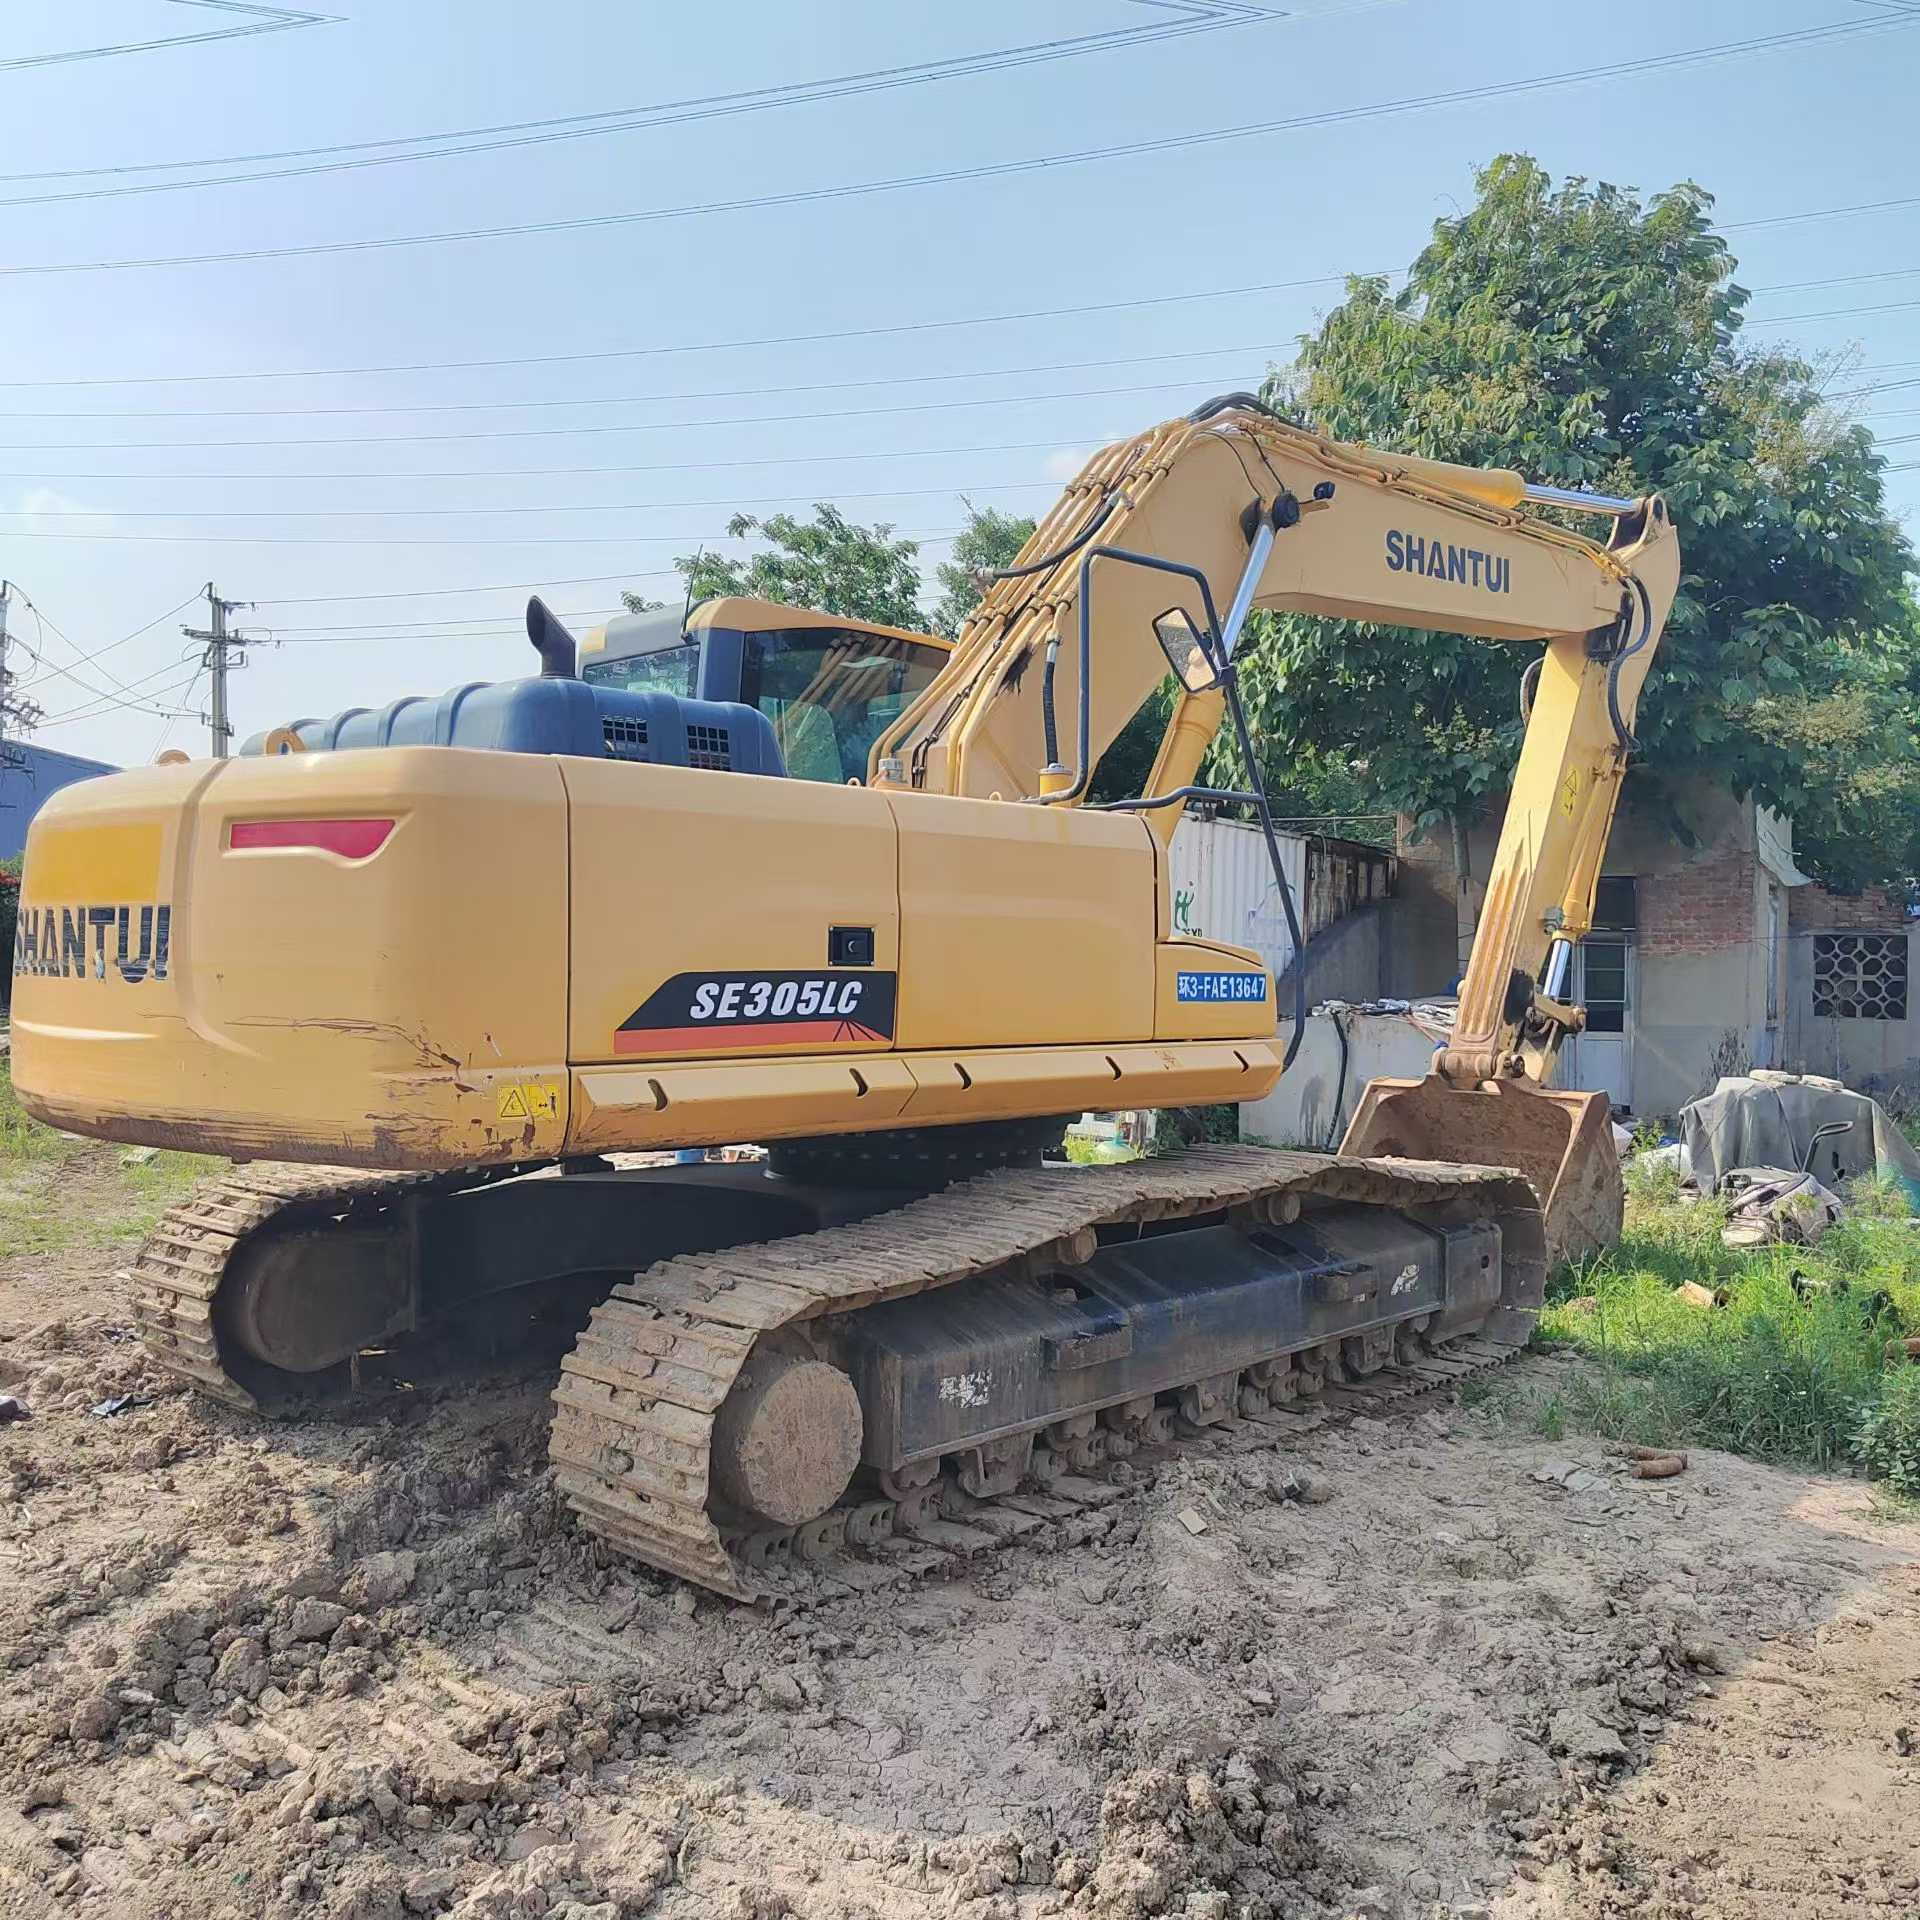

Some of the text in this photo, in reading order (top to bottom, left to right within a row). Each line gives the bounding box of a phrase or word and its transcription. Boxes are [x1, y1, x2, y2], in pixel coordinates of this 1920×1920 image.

[1386, 529, 1510, 593] SHANTUI
[689, 980, 862, 1019] SE305LC
[1178, 975, 1266, 999] 环3-FAE13647
